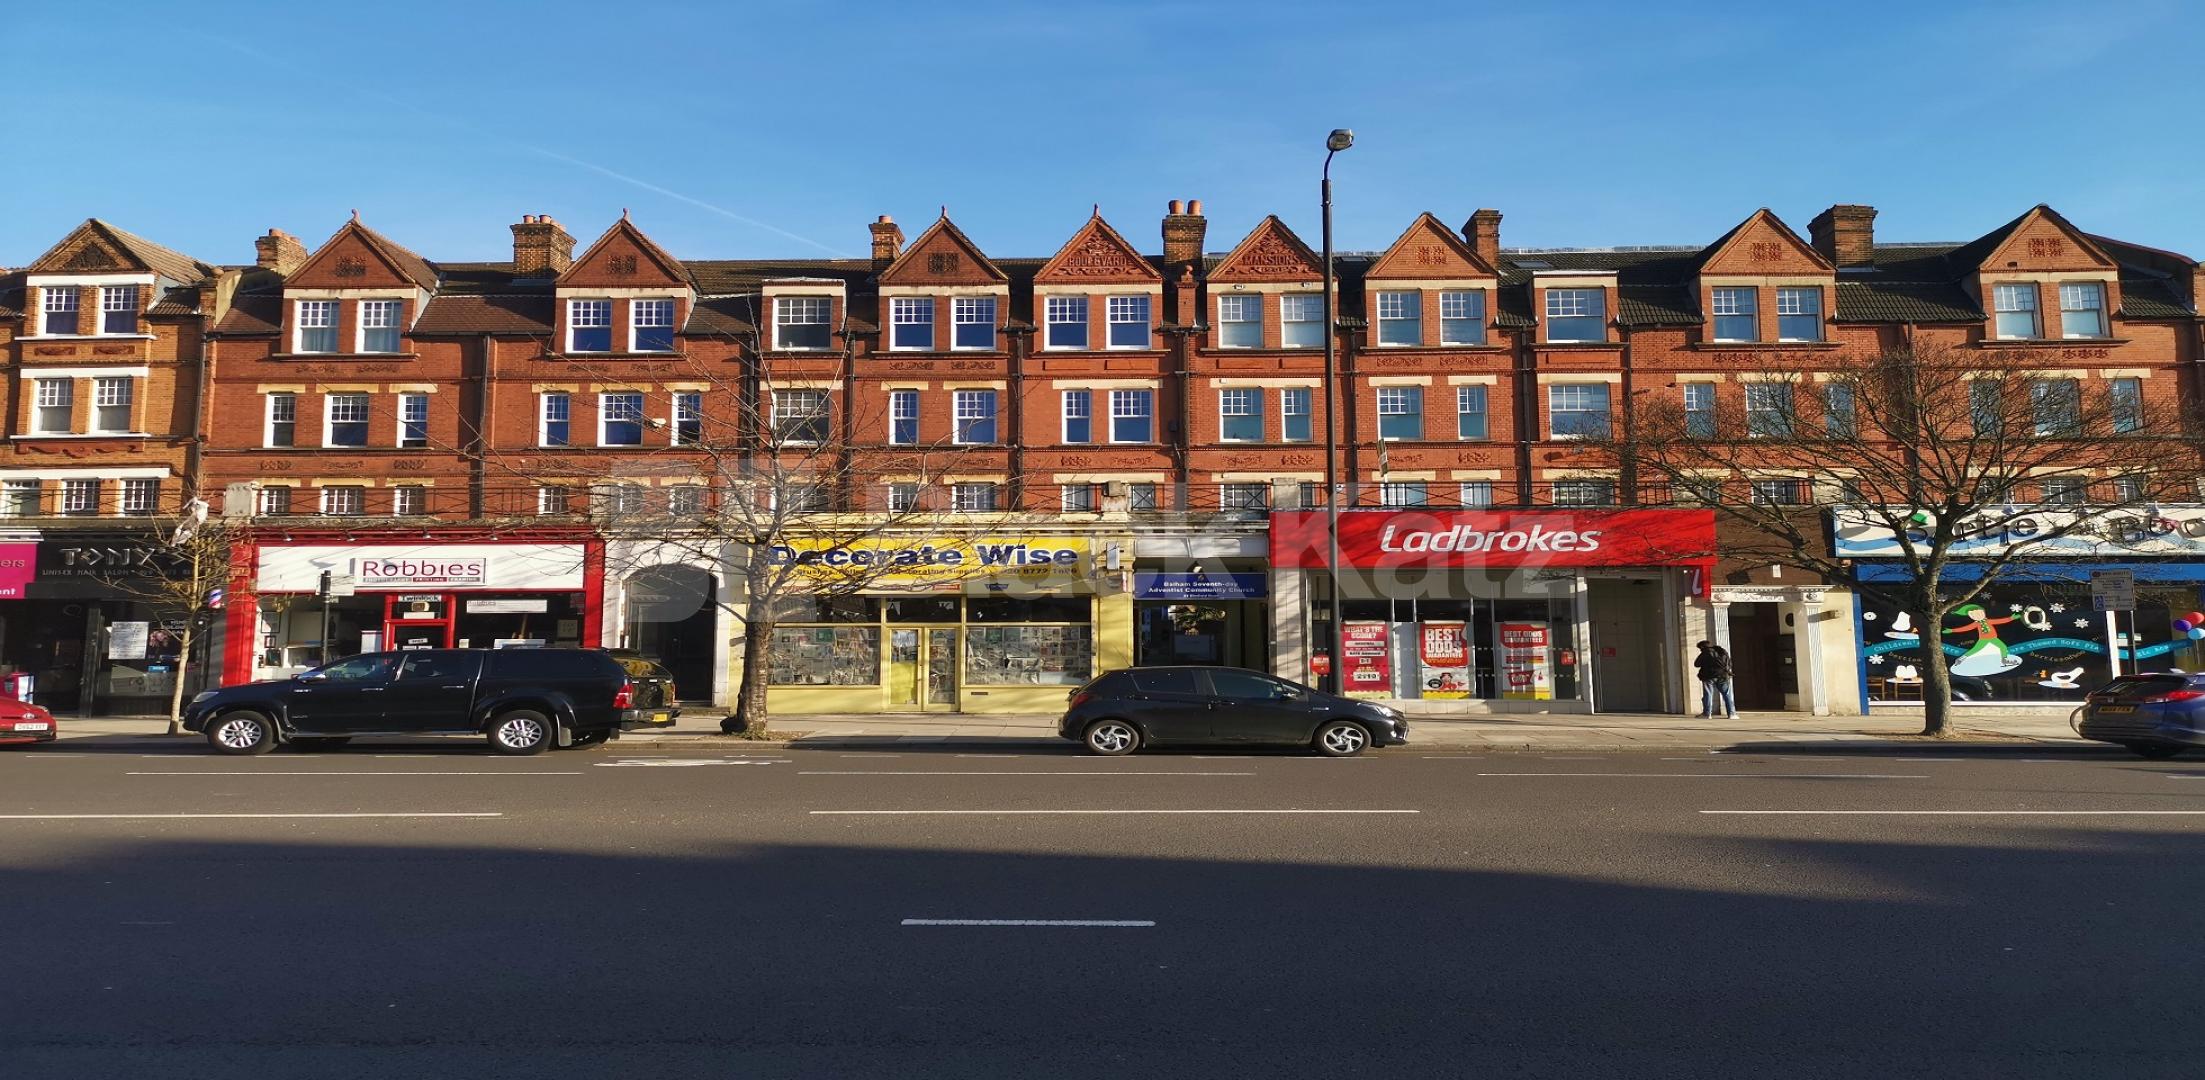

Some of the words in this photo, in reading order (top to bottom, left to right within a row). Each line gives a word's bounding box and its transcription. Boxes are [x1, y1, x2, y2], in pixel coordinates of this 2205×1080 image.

[1243, 254, 1300, 266] MANSIONS
[1380, 524, 1603, 552] Ladbrokes
[768, 545, 963, 566] Decorate
[975, 543, 1079, 566] Wise
[362, 560, 481, 577] Robbies
[1424, 628, 1462, 641] BEST
[1503, 630, 1522, 638] BEST
[1523, 630, 1543, 638] ODDS
[1426, 640, 1463, 653] ODDS
